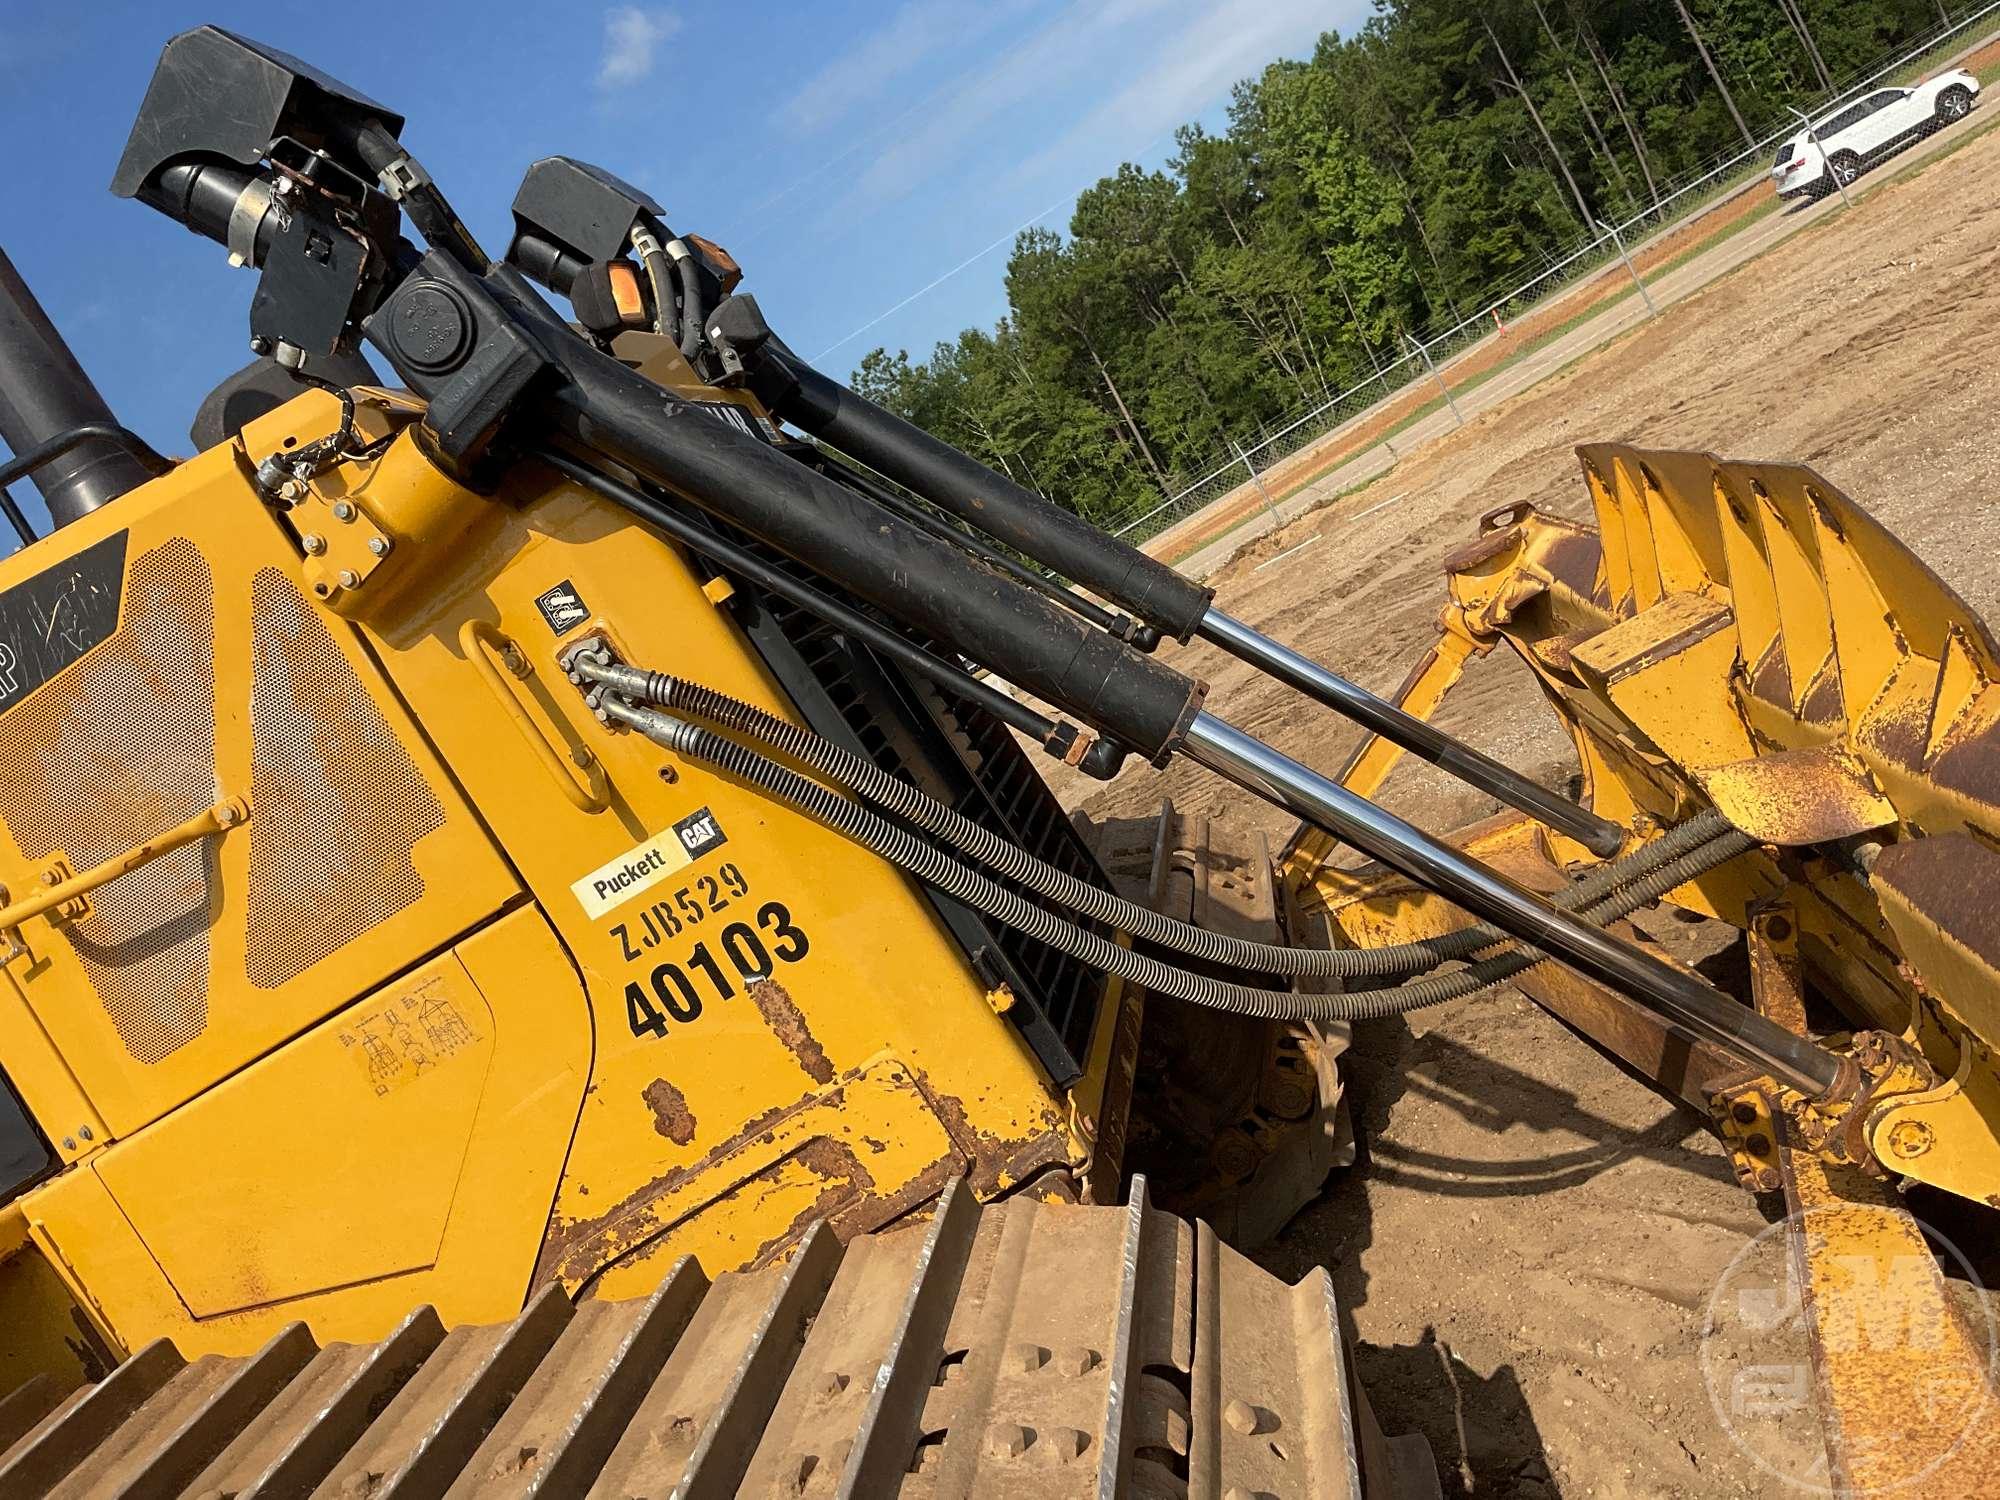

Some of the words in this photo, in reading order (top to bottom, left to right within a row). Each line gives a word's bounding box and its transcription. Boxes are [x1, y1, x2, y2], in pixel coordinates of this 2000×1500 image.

[594, 849, 666, 900] Puckett
[681, 817, 716, 849] CAT
[609, 863, 749, 962] ZJB529
[624, 902, 809, 1038] 40103
